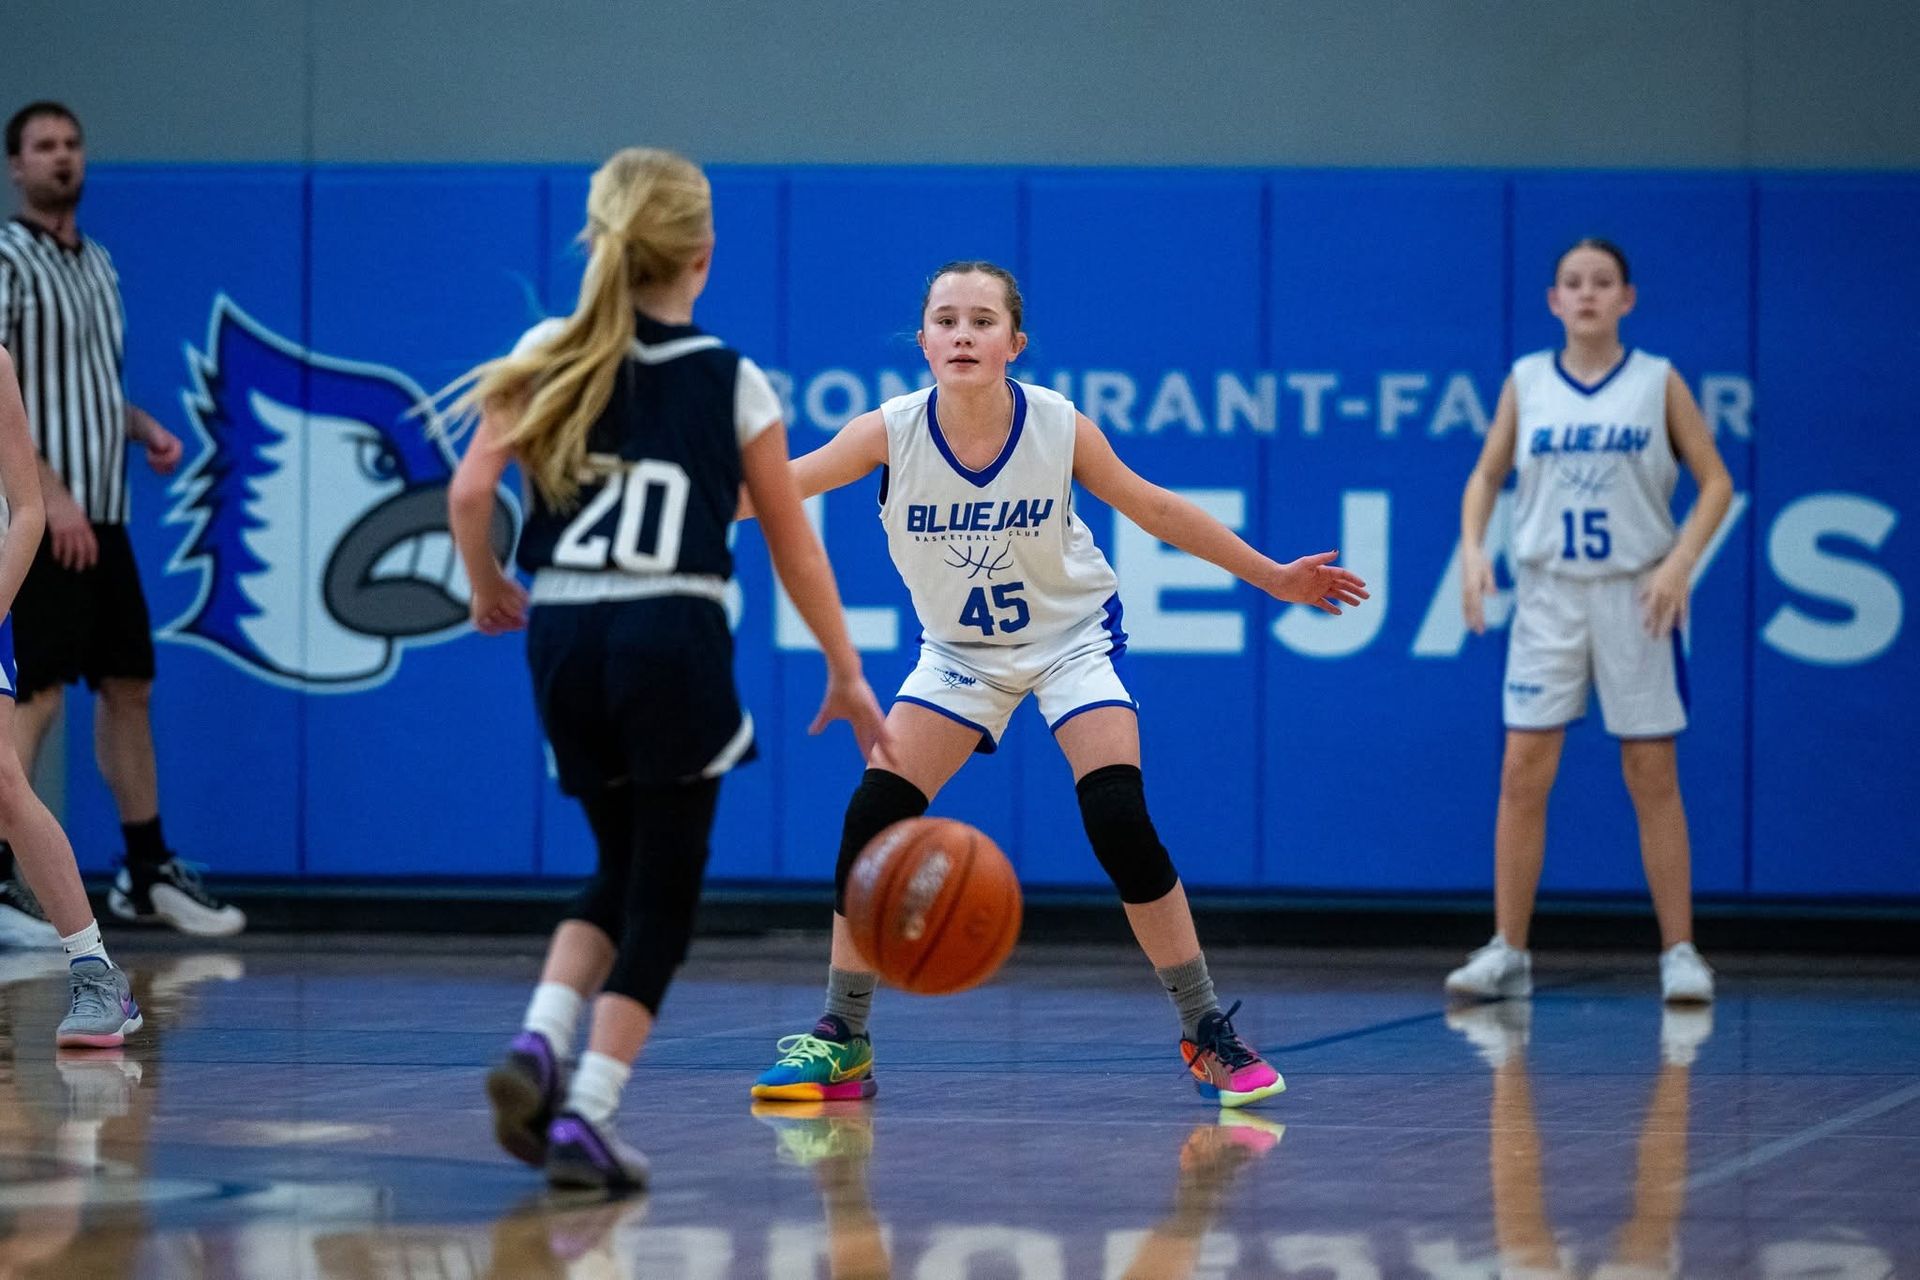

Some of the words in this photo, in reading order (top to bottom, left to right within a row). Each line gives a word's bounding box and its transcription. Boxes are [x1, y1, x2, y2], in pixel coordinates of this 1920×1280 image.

[552, 453, 691, 574] 20
[907, 499, 1054, 533] BLUEJAY
[914, 533, 998, 543] BASKETBALL
[1007, 529, 1040, 538] CLUB
[1562, 509, 1612, 561] 15
[958, 581, 1031, 636] 45
